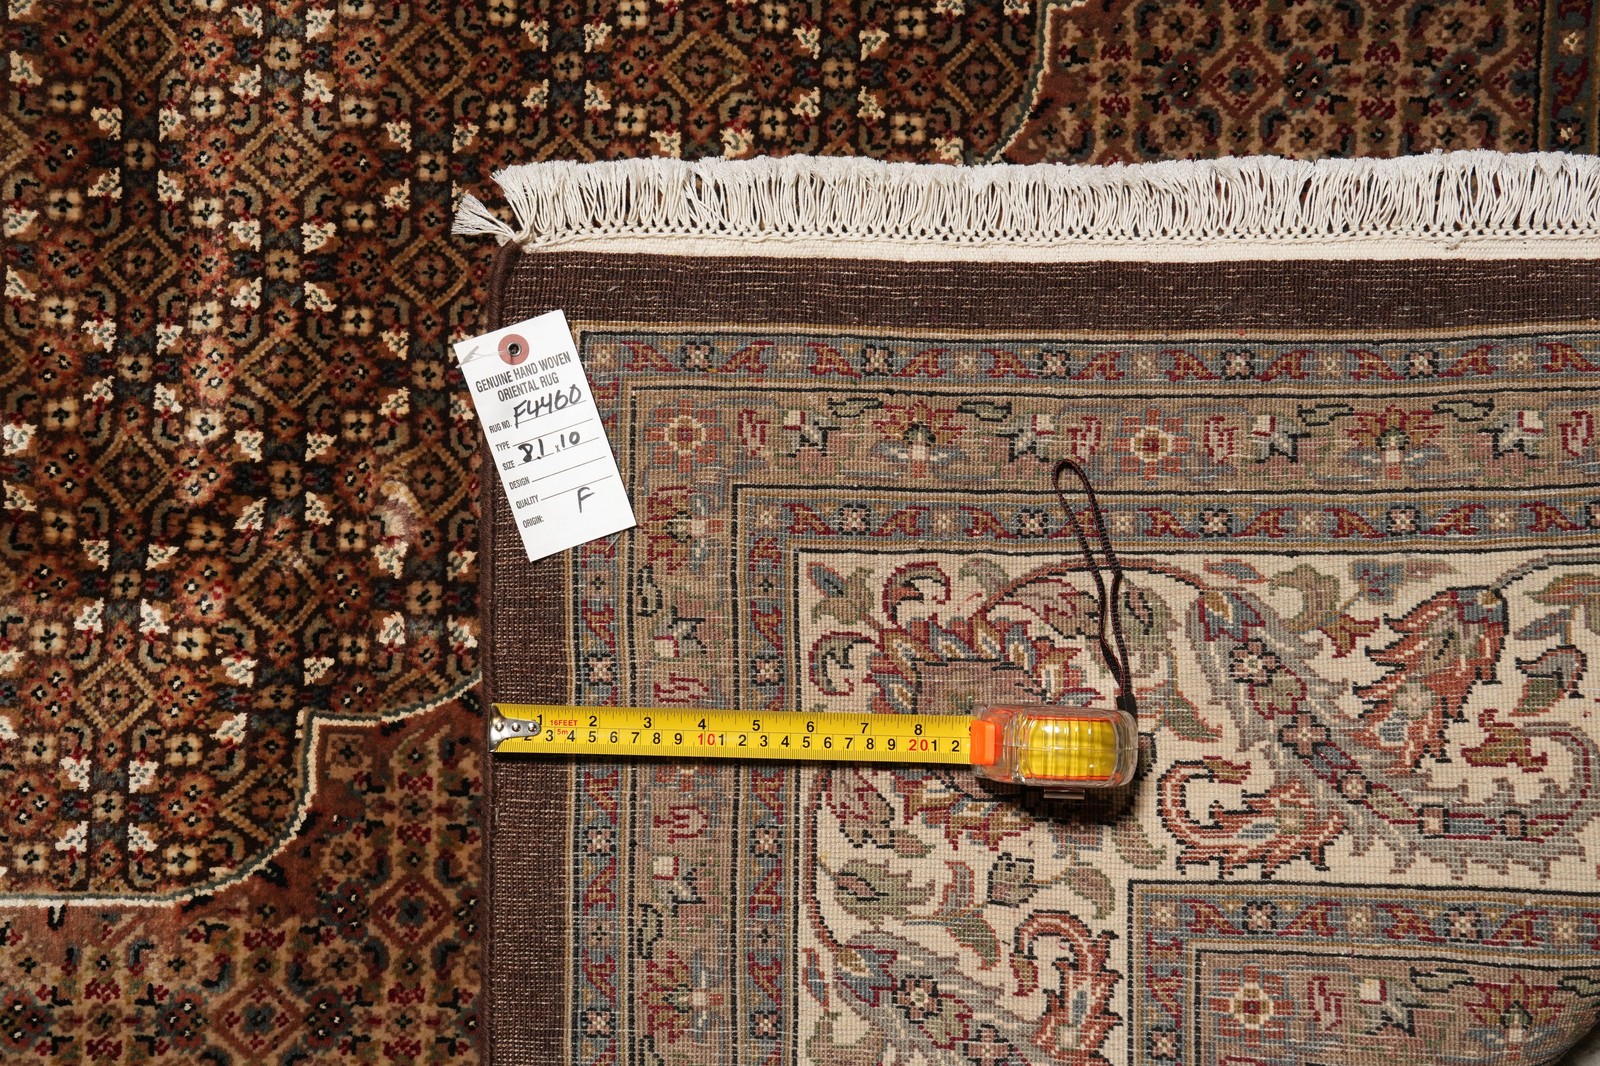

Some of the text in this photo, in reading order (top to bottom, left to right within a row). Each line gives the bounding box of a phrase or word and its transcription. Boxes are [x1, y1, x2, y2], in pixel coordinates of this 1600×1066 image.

[476, 352, 572, 392] GENUINE HAND WOVEN
[498, 372, 560, 402] ORIENTAL RUG
[513, 384, 582, 428] F4460
[489, 420, 512, 434] RUG NO.
[496, 441, 510, 452] TYPE
[560, 431, 580, 448] 10
[502, 460, 515, 470] SIZE
[509, 476, 530, 490] DESIGN
[516, 494, 540, 509] QUALITY
[522, 516, 544, 528] ORIGIN:
[589, 716, 598, 727] 2
[644, 717, 652, 728] 3
[698, 718, 706, 730] 4
[752, 720, 760, 731] 5
[806, 721, 814, 732] 6
[860, 722, 869, 734] 7
[914, 724, 922, 736] 8
[546, 730, 554, 742] 3
[566, 730, 576, 742] 4
[588, 731, 596, 742] 5
[610, 732, 618, 743] 6
[631, 732, 640, 744] 7
[652, 732, 660, 744] 8
[674, 733, 682, 744] 9
[698, 733, 716, 746] 10
[738, 734, 746, 746] 2
[760, 736, 768, 746] 3
[781, 736, 790, 748] 4
[802, 736, 810, 748] 5
[824, 737, 832, 748] 6
[845, 738, 853, 748] 7
[866, 738, 874, 750] 8
[888, 738, 896, 750] 9
[908, 740, 928, 750] 20
[952, 740, 960, 752] 2
